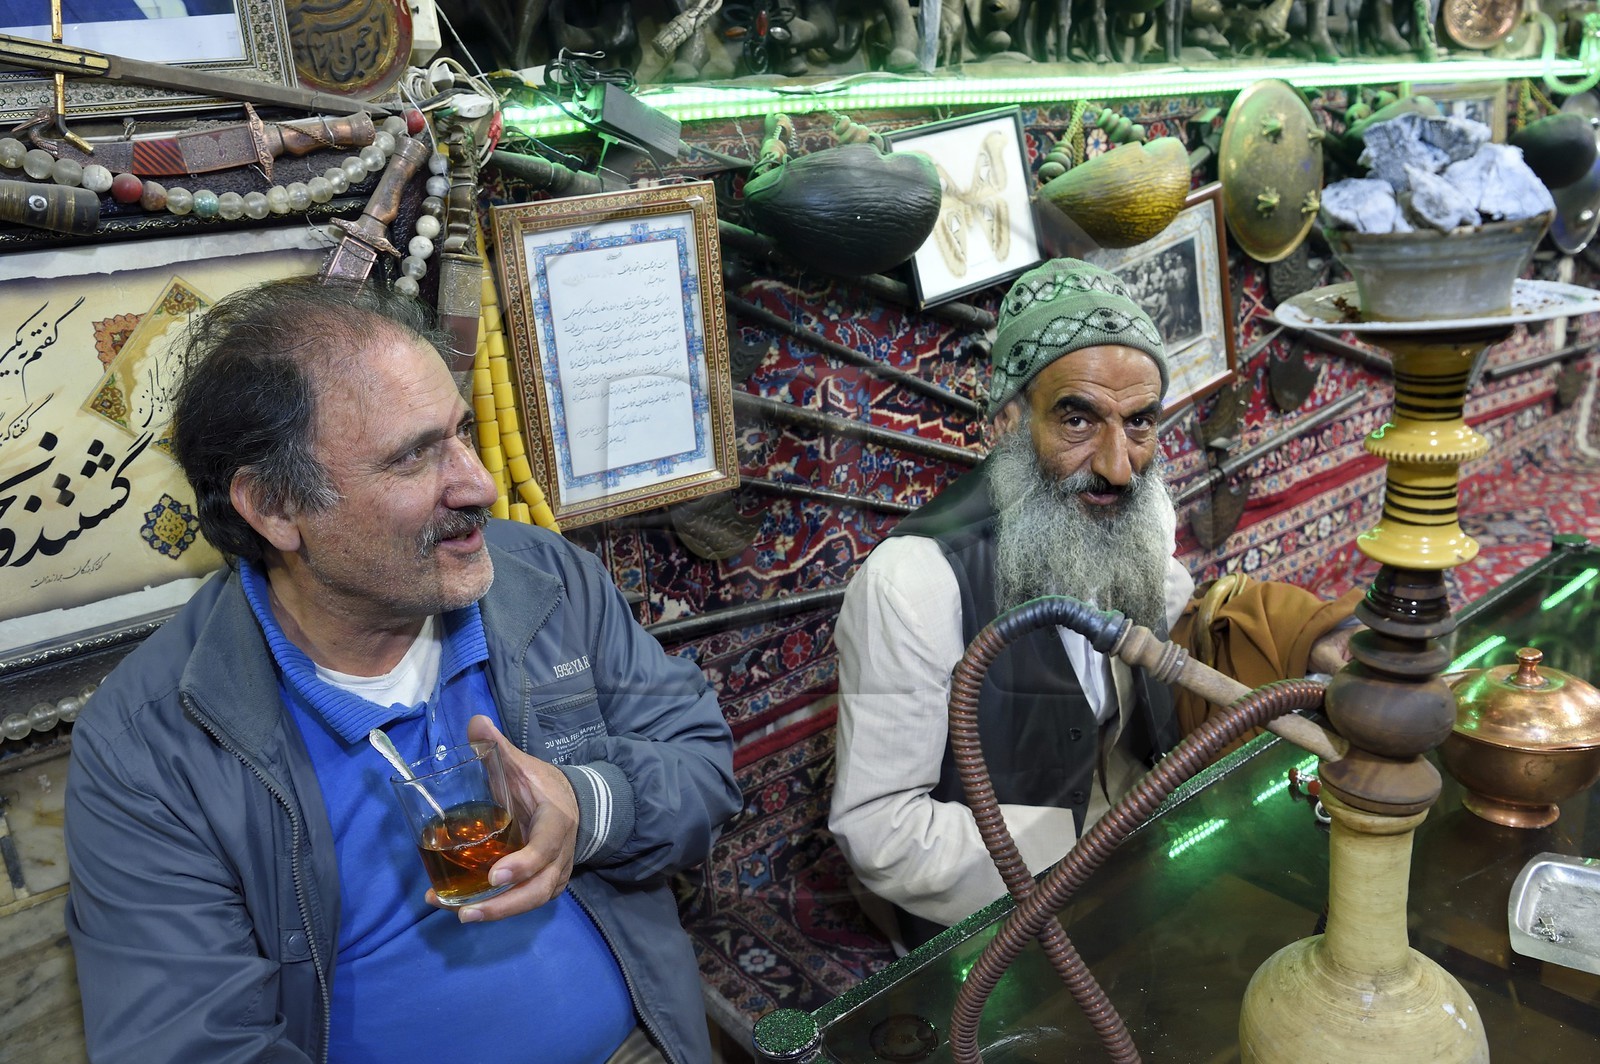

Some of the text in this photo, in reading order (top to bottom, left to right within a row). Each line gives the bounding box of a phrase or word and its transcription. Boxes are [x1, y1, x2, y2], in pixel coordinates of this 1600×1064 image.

[21, 296, 86, 404] گفتم
[3, 402, 33, 441] که
[12, 393, 55, 439] گفتا
[554, 736, 570, 746] WILL
[570, 732, 581, 741] FEEL
[580, 725, 597, 735] HAPPY
[558, 755, 565, 763] IS
